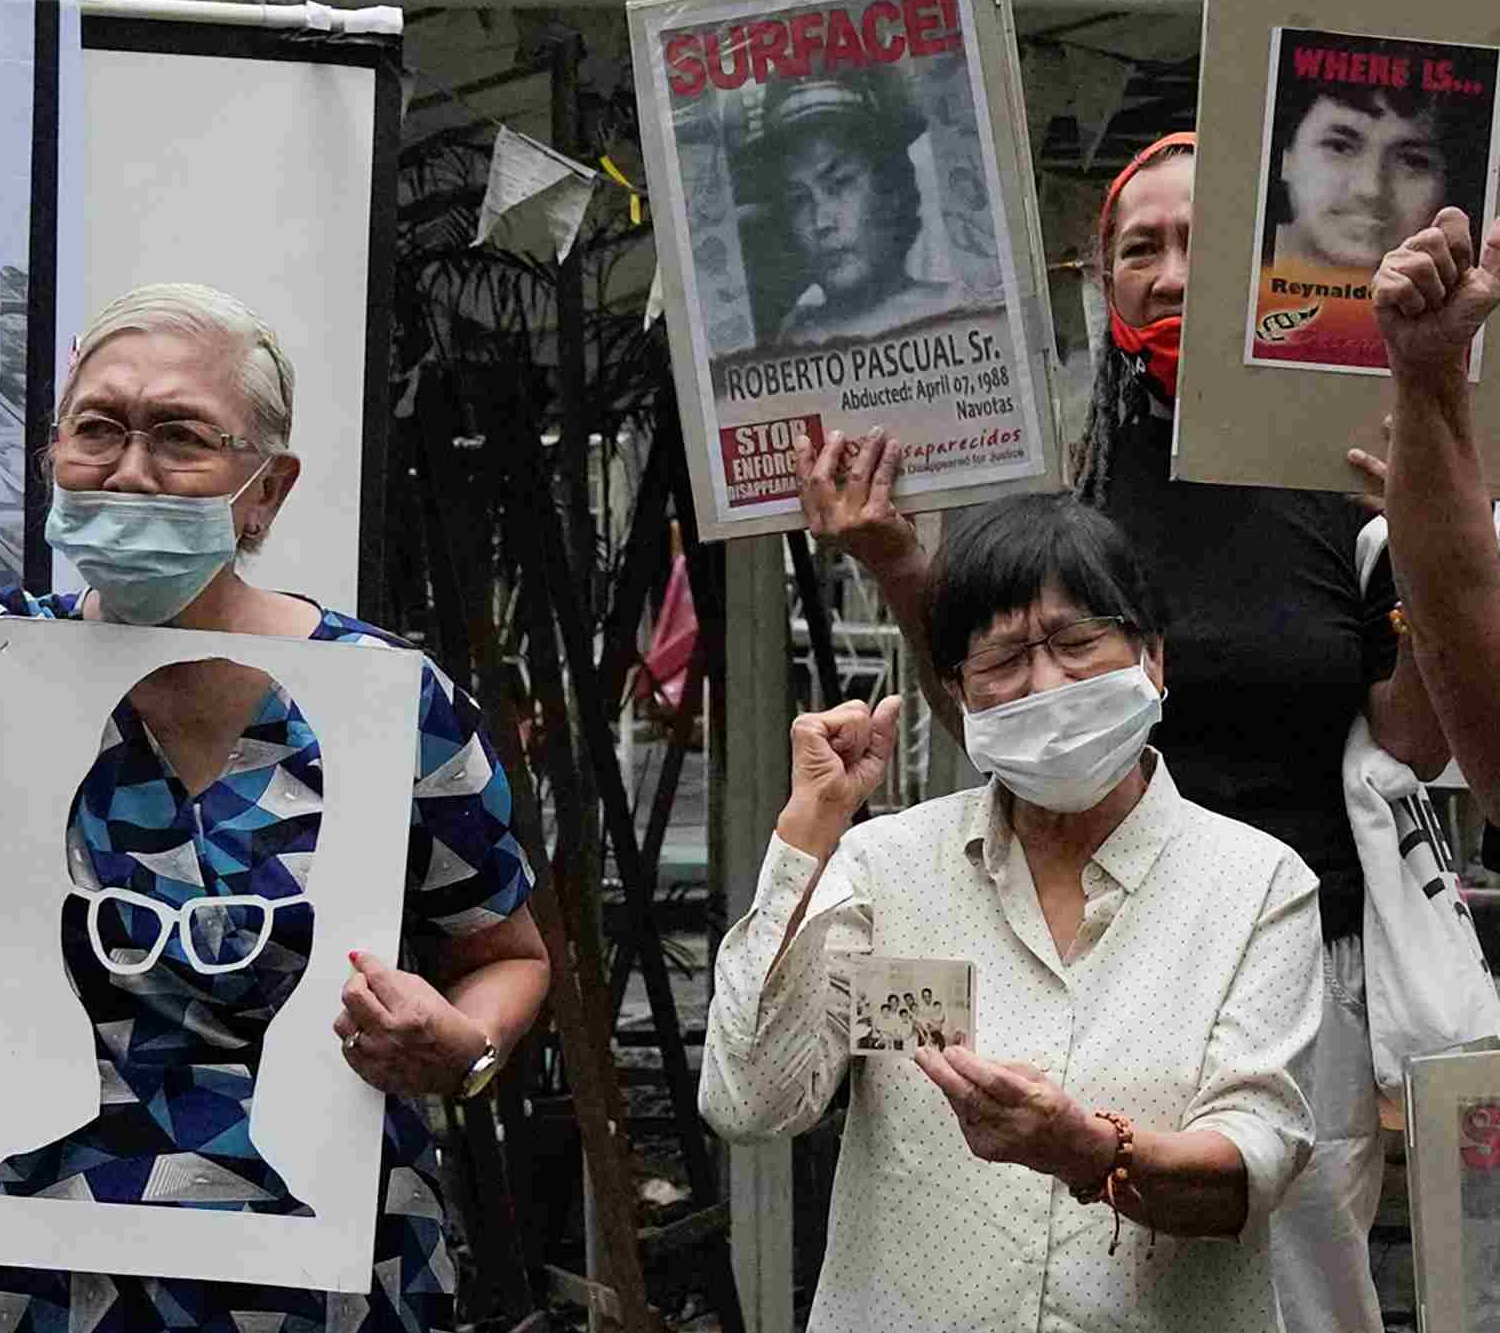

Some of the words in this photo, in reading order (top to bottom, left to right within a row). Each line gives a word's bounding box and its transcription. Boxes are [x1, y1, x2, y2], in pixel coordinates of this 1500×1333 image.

[1293, 46, 1412, 88] WHERE
[726, 352, 845, 401] ROBERTO
[850, 334, 964, 381] PASCUAL
[968, 329, 1000, 364] Sr.
[841, 381, 913, 411] Abducted:
[916, 375, 950, 404] April
[953, 376, 975, 397] 07,
[977, 365, 1010, 393] 1988
[956, 397, 1014, 420] Navotas
[735, 418, 808, 456] STOP
